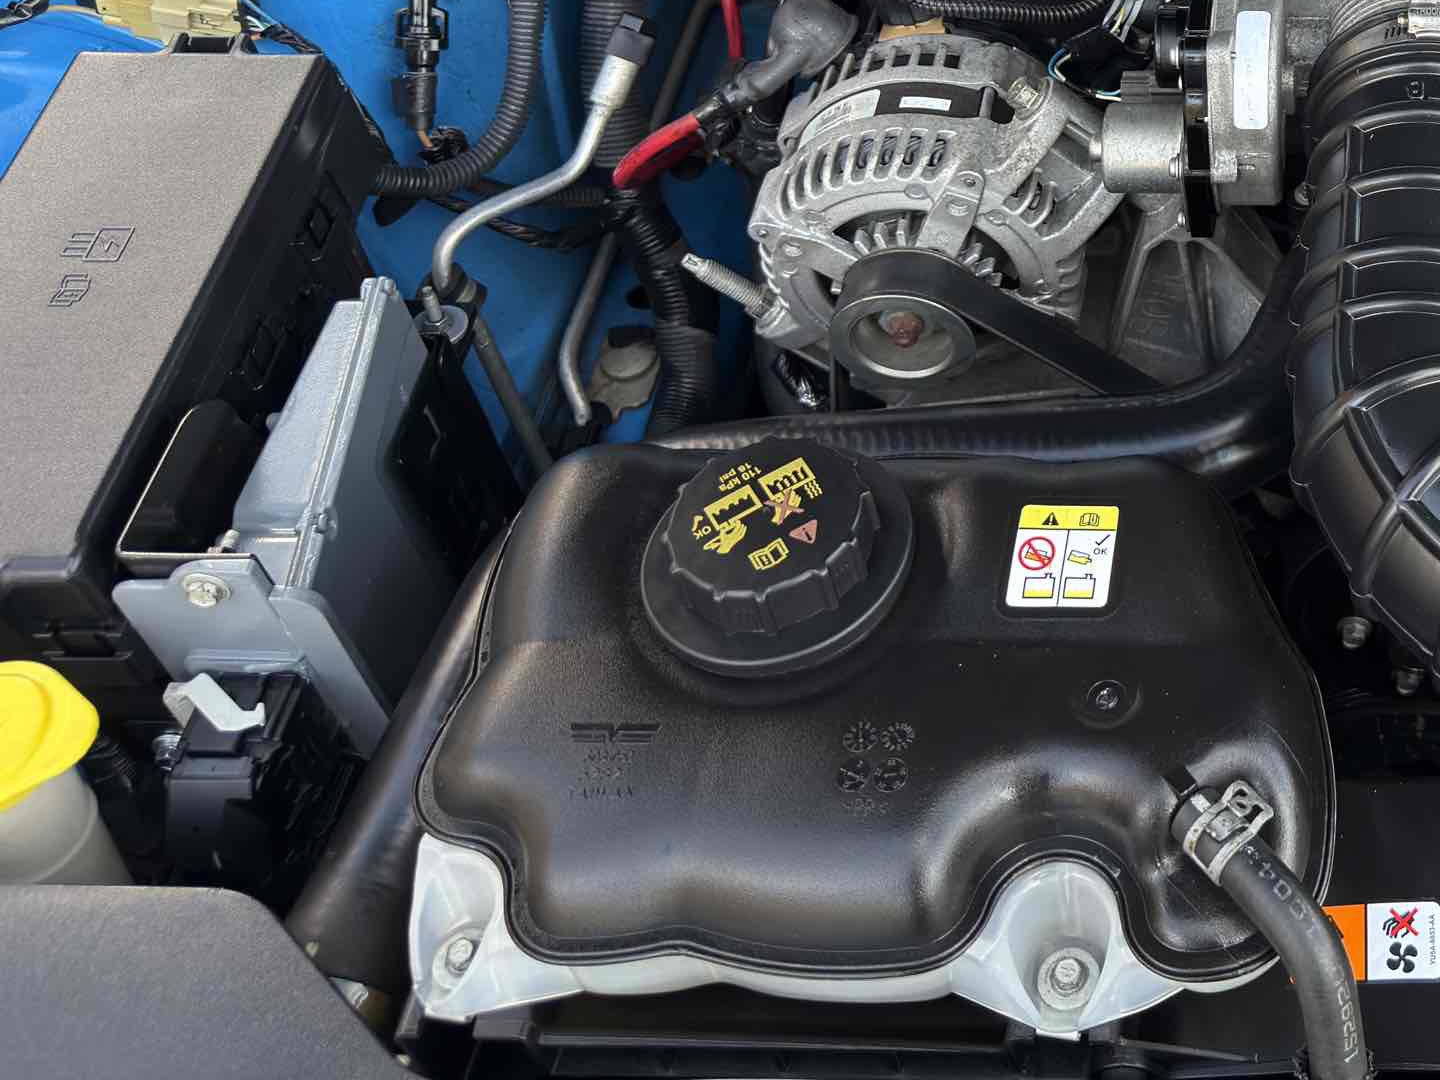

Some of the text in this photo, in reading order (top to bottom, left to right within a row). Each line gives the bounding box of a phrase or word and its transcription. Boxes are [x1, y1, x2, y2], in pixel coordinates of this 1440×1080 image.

[718, 466, 762, 492] 110 kPa
[719, 468, 737, 483] psi
[692, 525, 712, 540] OK
[1093, 547, 1108, 556] OK
